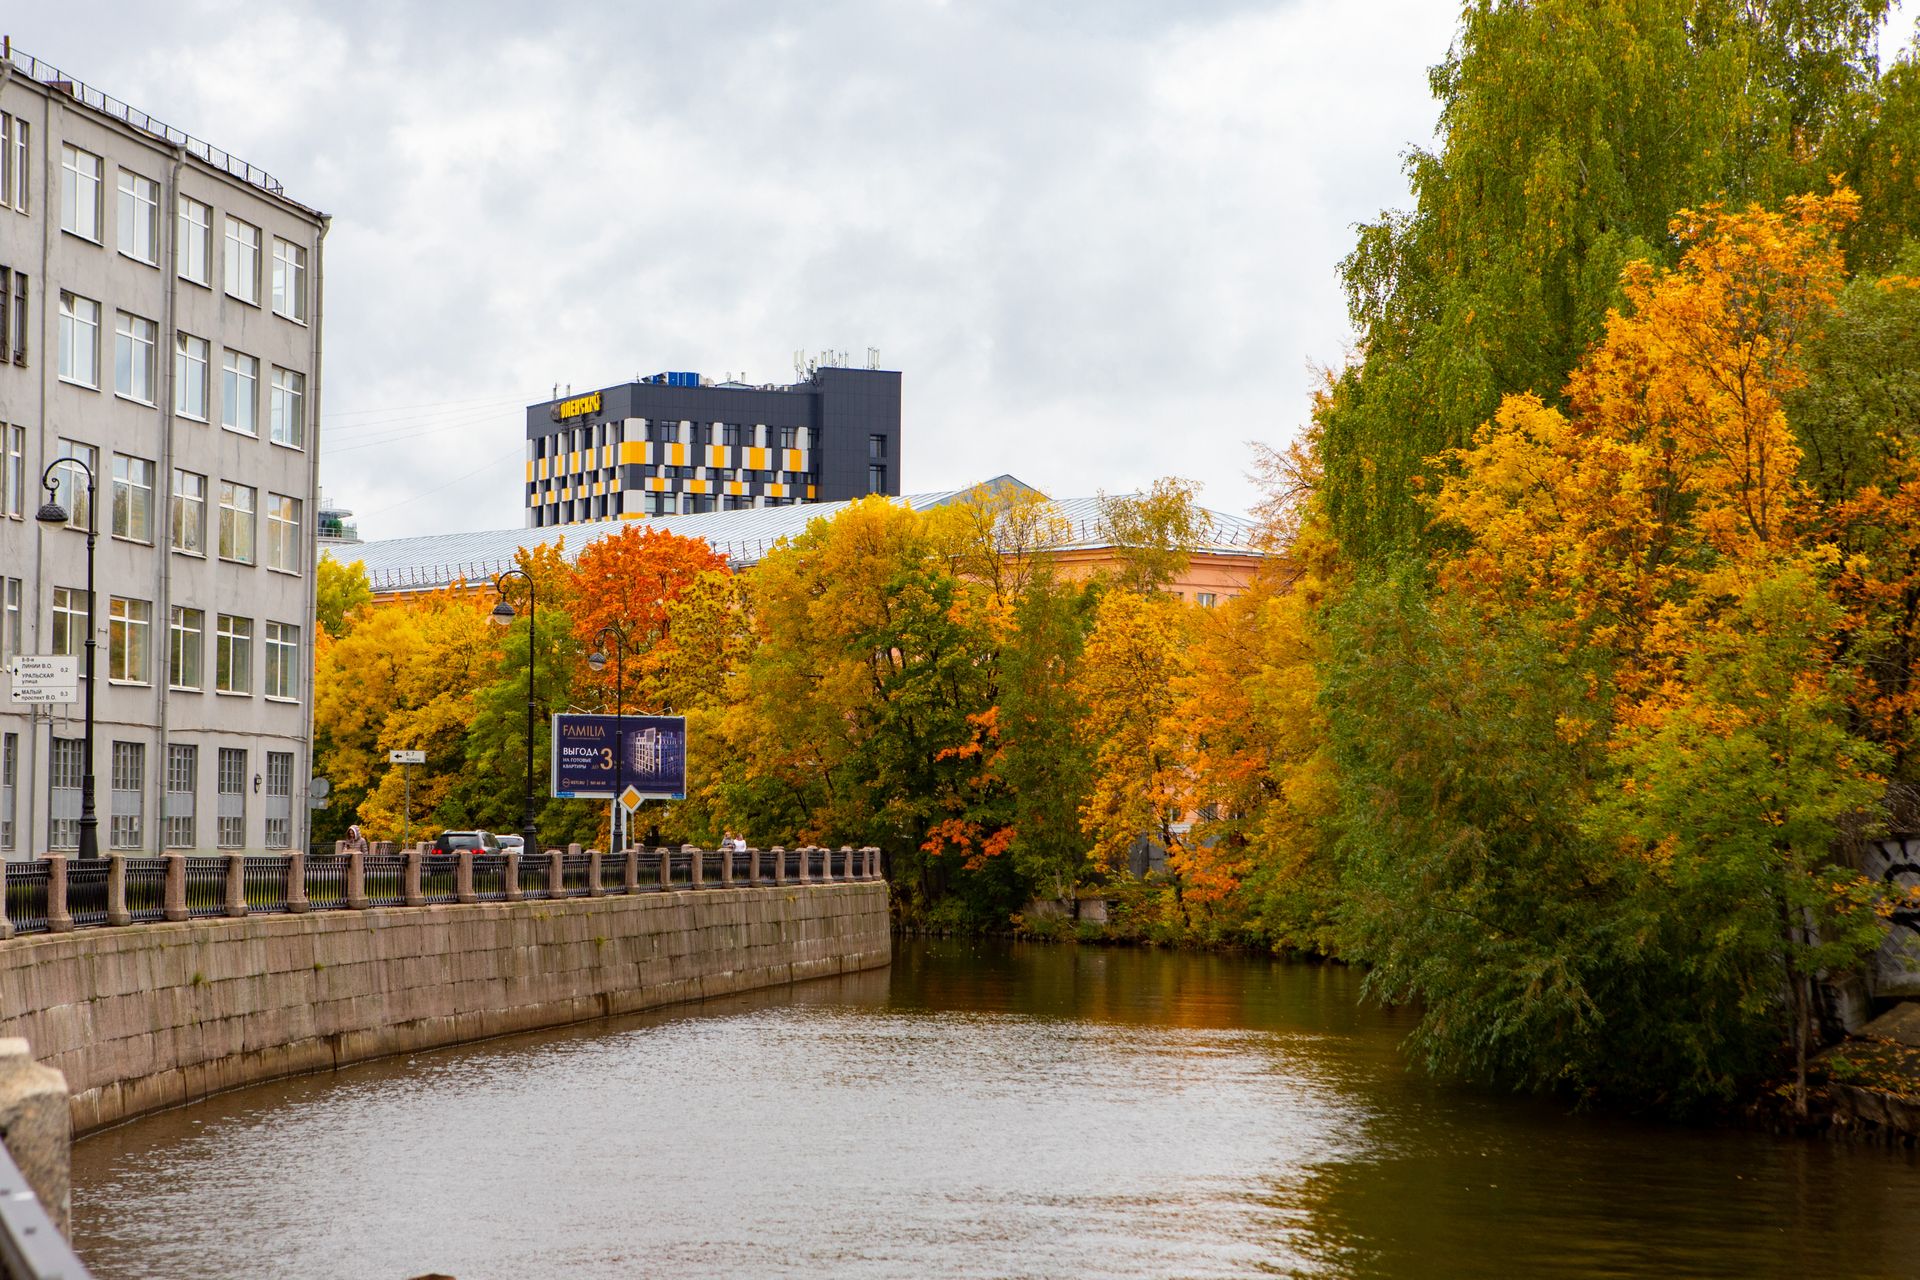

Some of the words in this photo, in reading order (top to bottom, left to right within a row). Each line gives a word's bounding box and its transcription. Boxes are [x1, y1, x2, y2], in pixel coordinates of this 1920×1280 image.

[563, 725, 606, 737] FAMILIA
[563, 748, 599, 756] ВЫГОДА
[600, 748, 613, 770] 3
